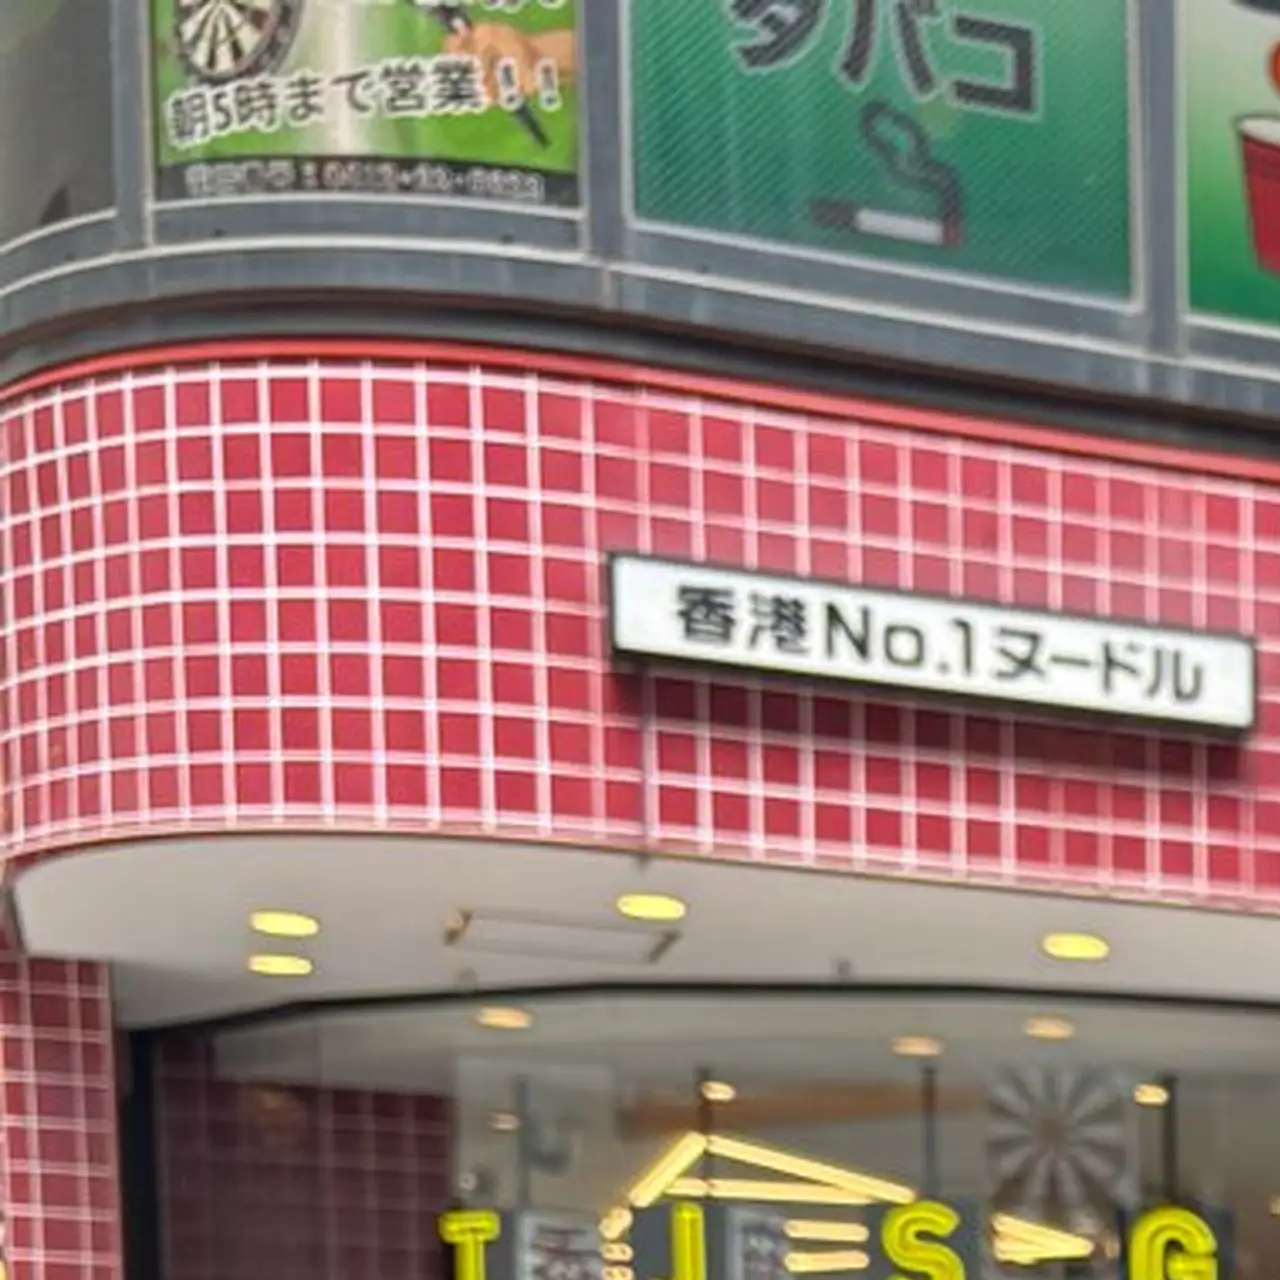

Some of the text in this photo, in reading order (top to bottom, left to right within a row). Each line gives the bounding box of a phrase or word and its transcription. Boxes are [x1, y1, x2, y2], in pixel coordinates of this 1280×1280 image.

[674, 582, 1206, 706] 香港No.1ヌードル
